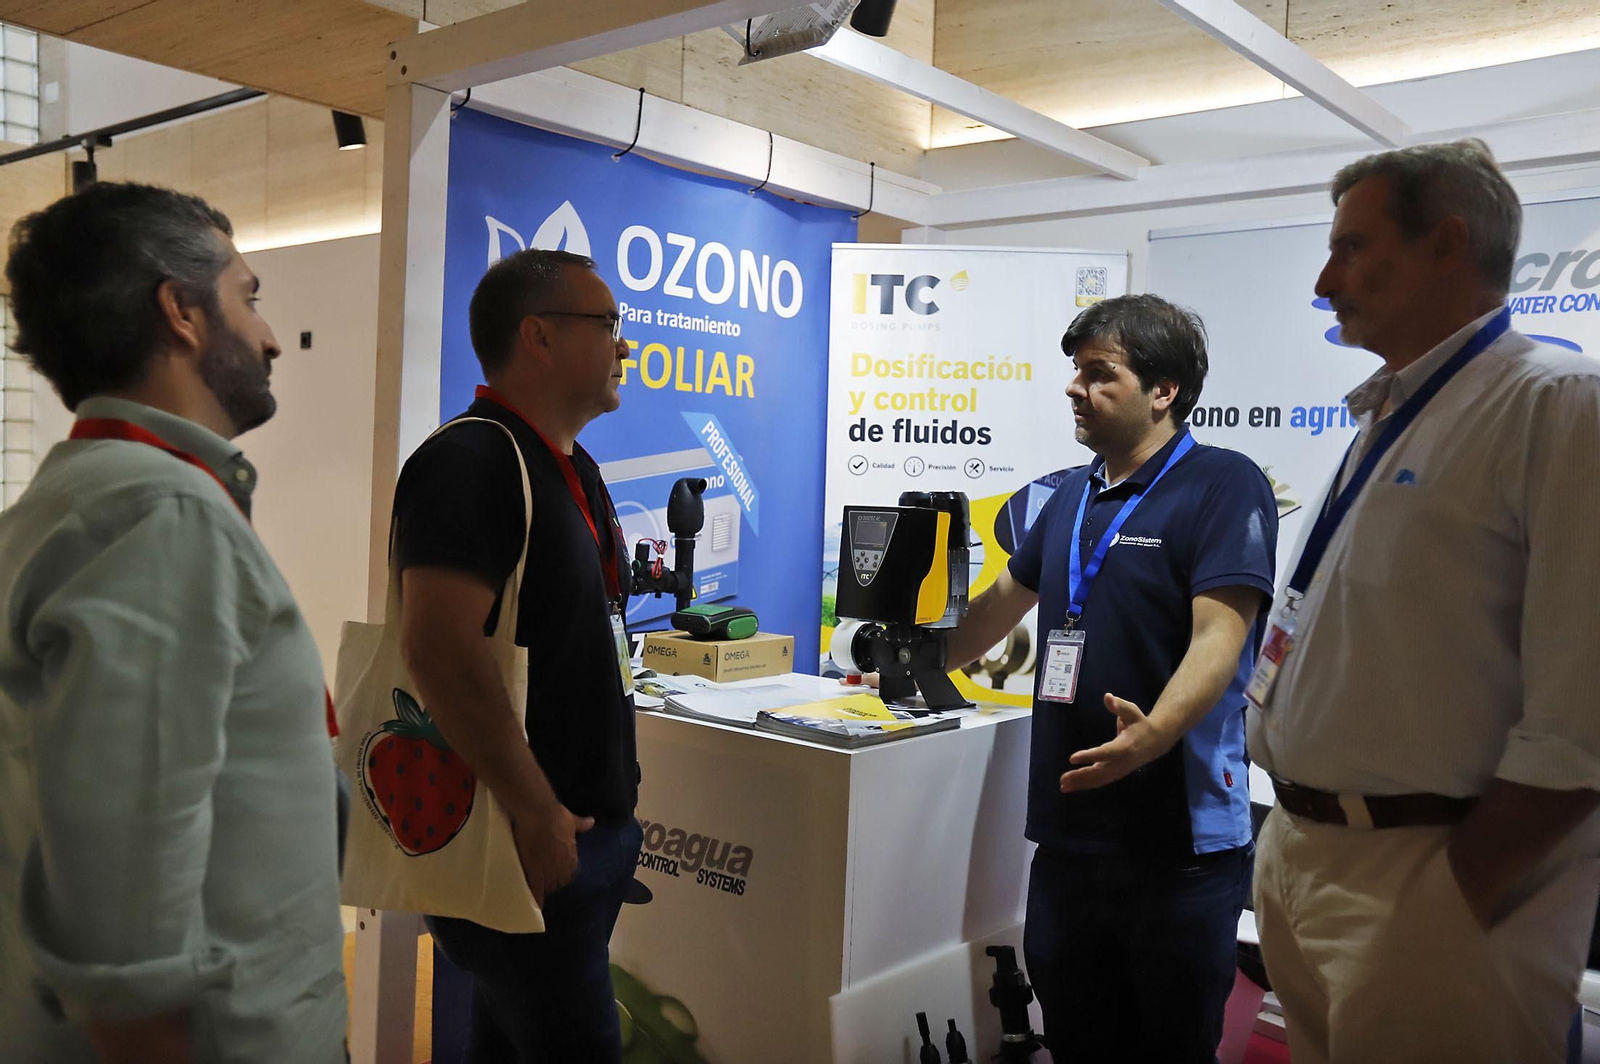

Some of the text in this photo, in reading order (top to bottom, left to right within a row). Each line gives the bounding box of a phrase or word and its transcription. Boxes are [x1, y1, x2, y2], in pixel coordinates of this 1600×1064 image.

[617, 225, 803, 318] OZONO
[852, 273, 941, 315] ITC
[619, 302, 741, 337] Para tratamiento
[851, 322, 941, 331] DOSING PUMPS
[620, 339, 755, 398] FOLIAR
[851, 352, 1032, 381] Dosificación
[848, 387, 977, 415] y control
[849, 417, 992, 445] de fluidos
[1186, 406, 1240, 428] ono
[1248, 406, 1281, 428] en
[701, 420, 755, 512] PROFESIONAL
[872, 461, 1015, 473] Calidad Precisión Servicio
[1120, 535, 1162, 544] ZonoSistem
[646, 644, 678, 658] OMEGA
[724, 650, 750, 661] OMEGA
[696, 868, 746, 896] SYSTEMS
